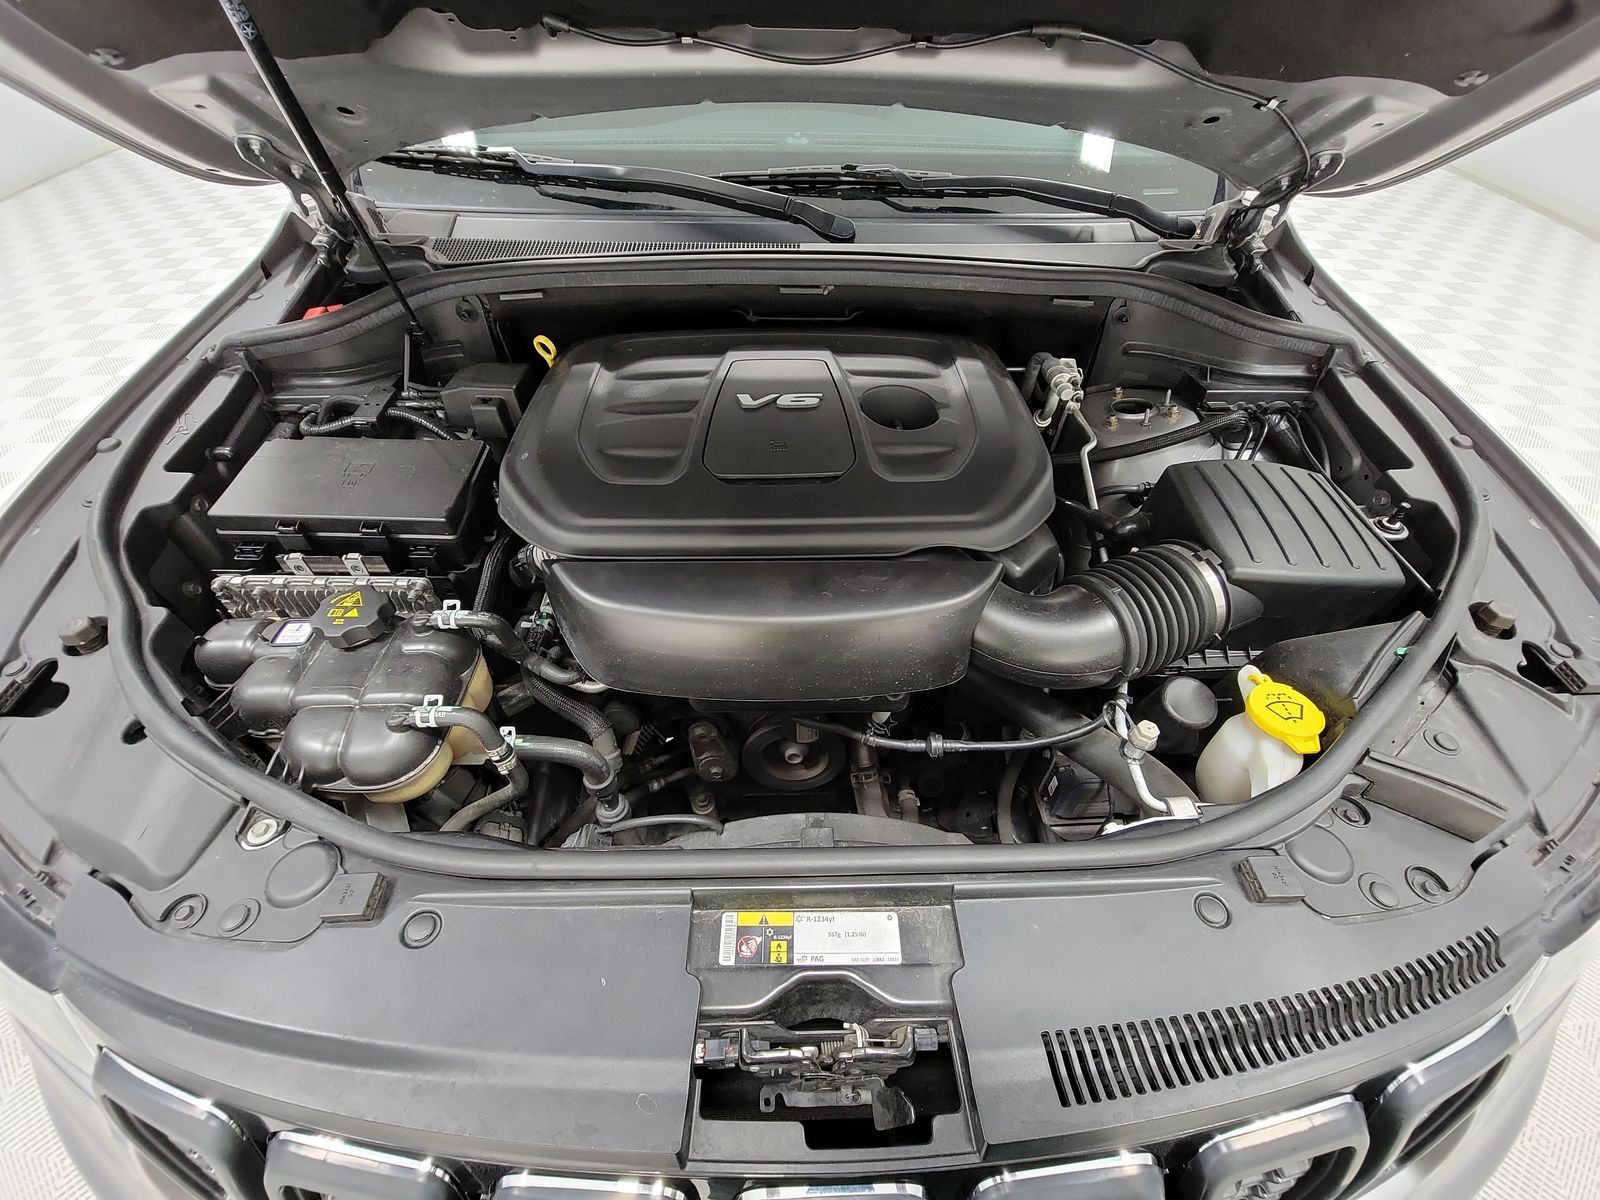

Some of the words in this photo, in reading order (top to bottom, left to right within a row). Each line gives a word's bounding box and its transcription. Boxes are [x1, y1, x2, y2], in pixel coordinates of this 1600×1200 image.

[736, 392, 824, 409] V6
[806, 915, 835, 924] R-1234yf
[810, 955, 825, 963] PAG
